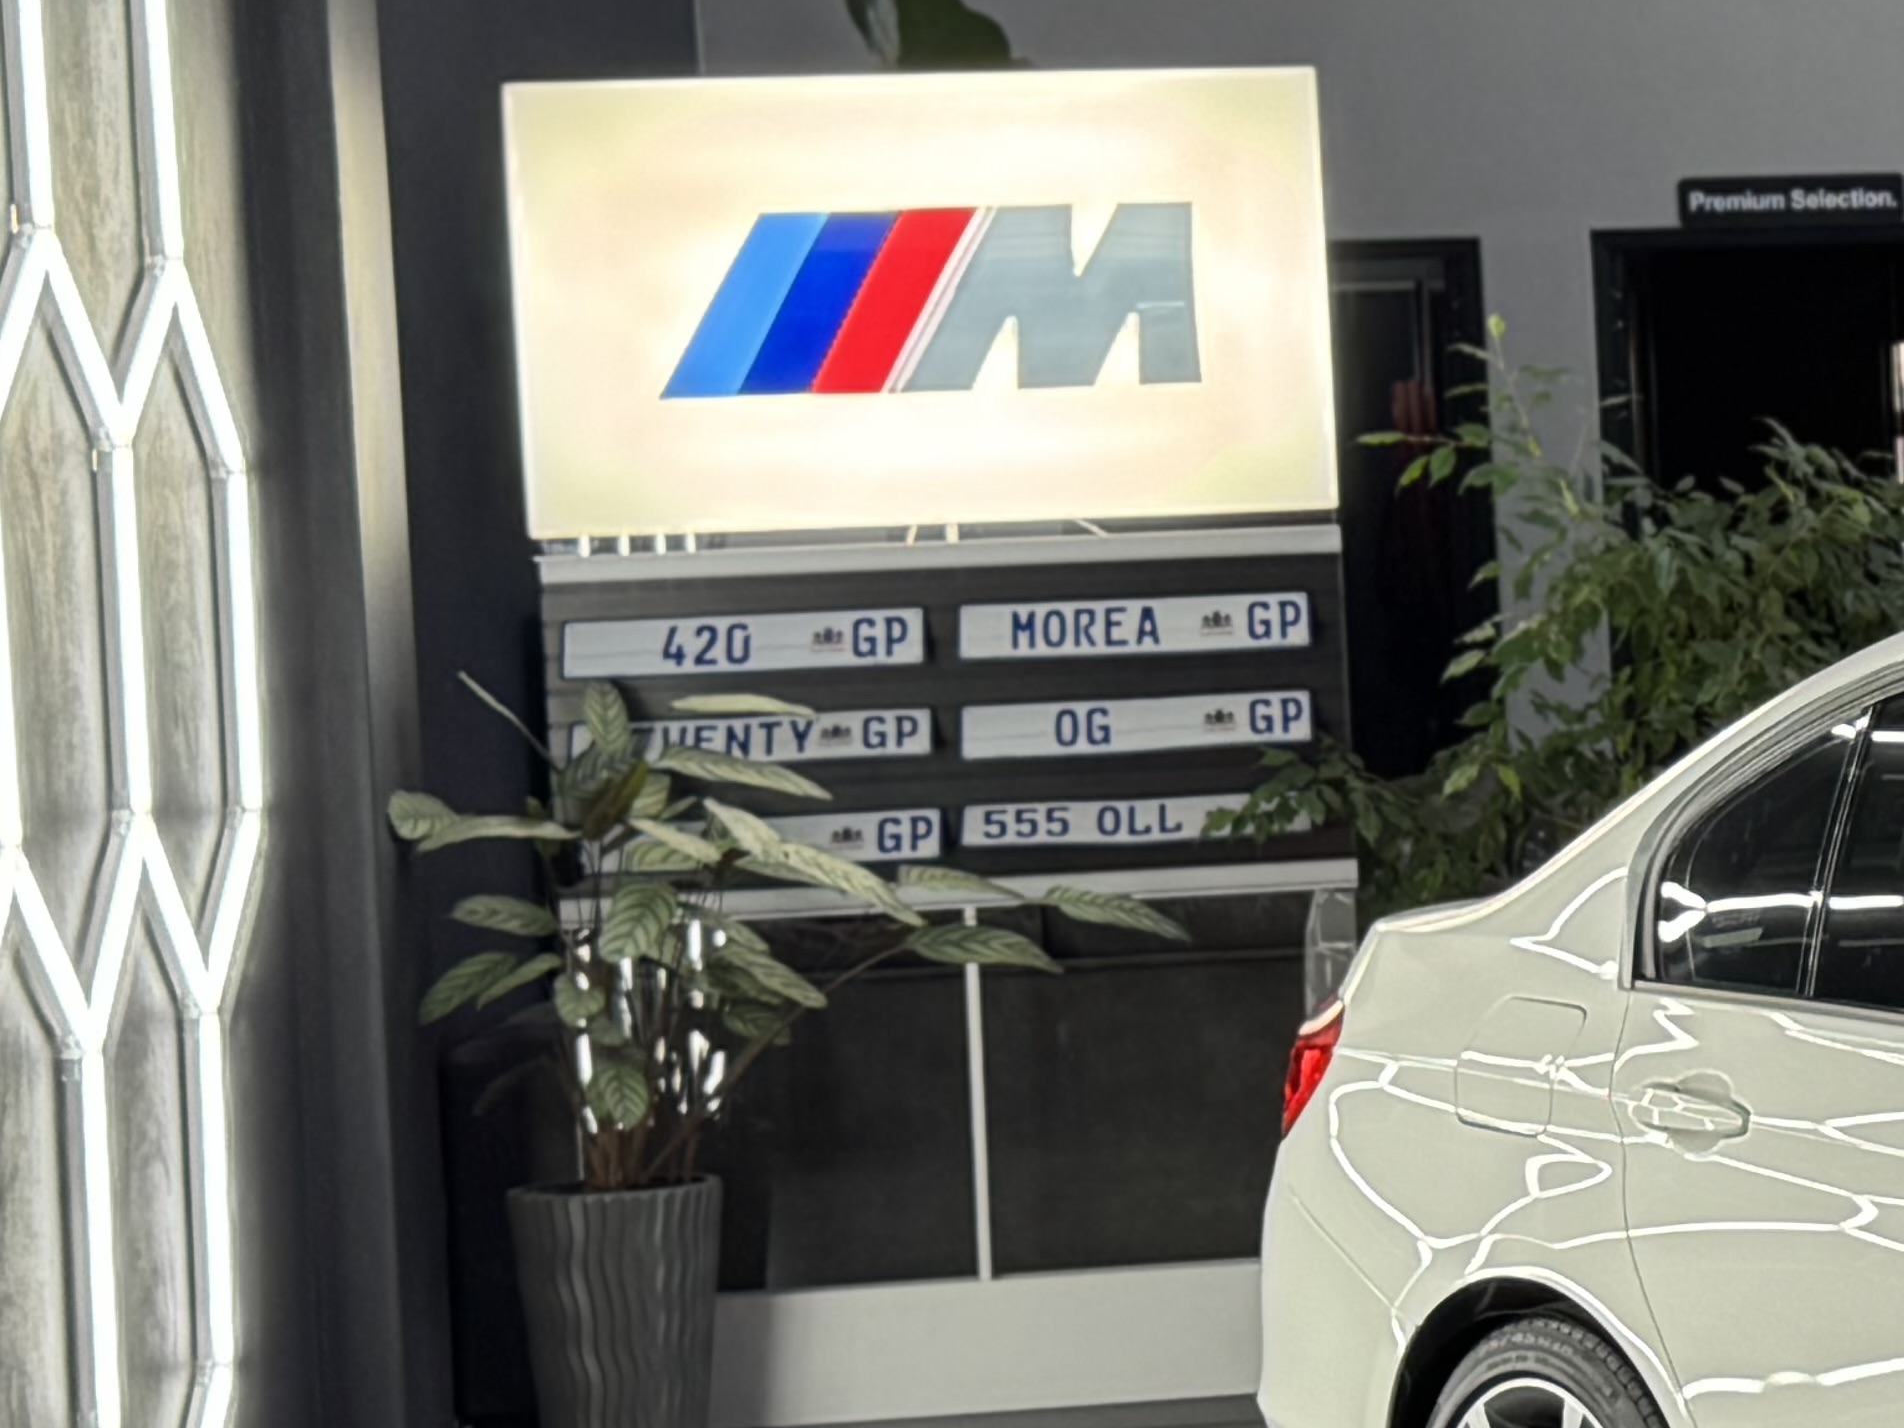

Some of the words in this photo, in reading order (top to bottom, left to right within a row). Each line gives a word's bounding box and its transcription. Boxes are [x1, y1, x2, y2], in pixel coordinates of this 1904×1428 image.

[1688, 190, 1786, 213] Premium
[1789, 187, 1898, 210] Selection.
[662, 622, 751, 667] 420
[851, 616, 909, 659] GP
[1011, 605, 1161, 651] MOREA
[1246, 599, 1301, 641] GP
[862, 715, 920, 749] GP
[1054, 707, 1112, 747] OG
[1248, 697, 1303, 735] GP
[877, 816, 934, 853] GP
[983, 806, 1071, 839] 555
[1097, 803, 1183, 836] OLL
